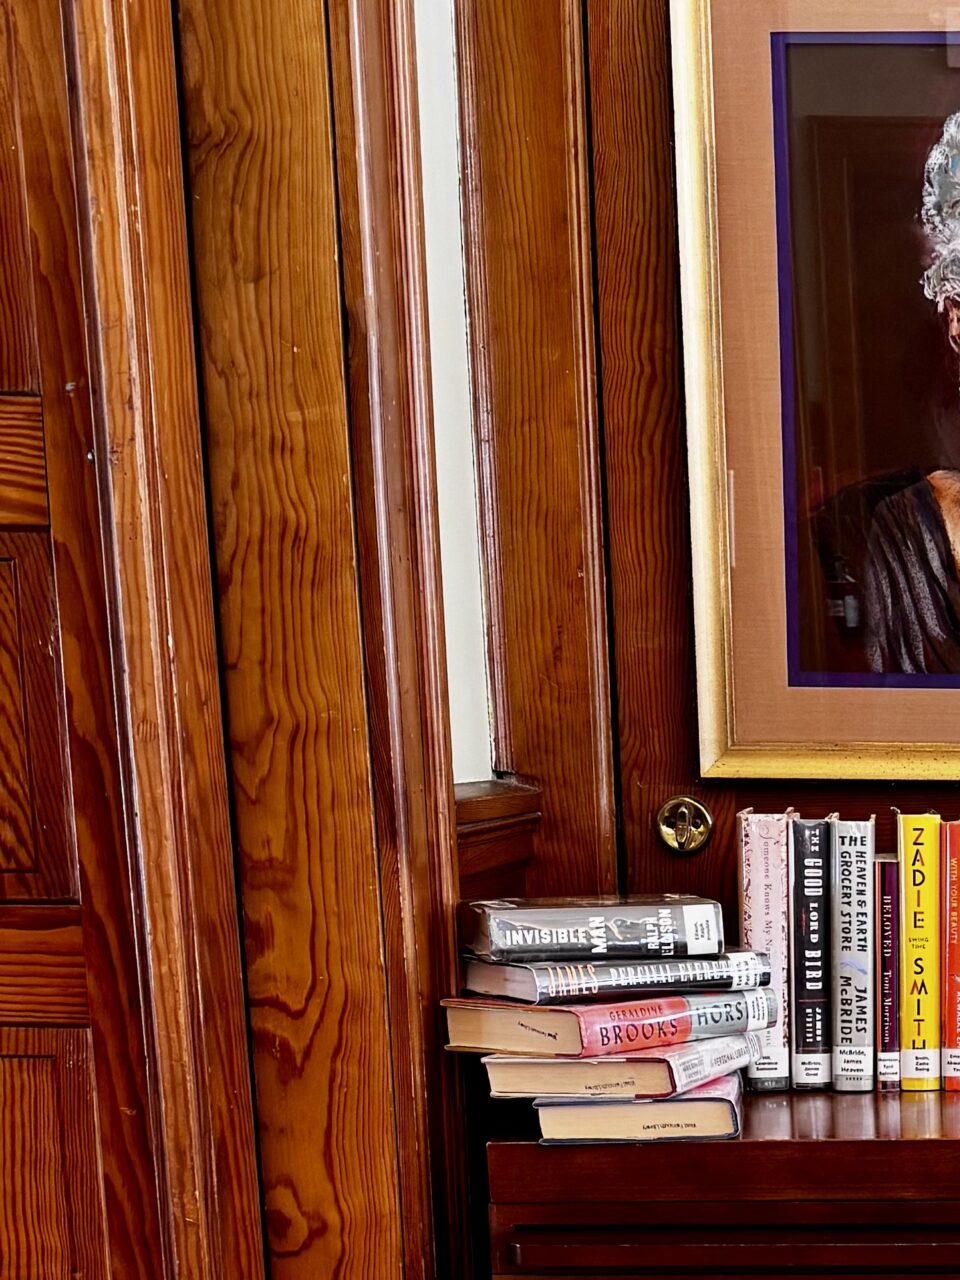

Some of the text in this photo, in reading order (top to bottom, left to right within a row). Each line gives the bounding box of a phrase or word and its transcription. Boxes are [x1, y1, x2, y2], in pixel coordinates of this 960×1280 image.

[839, 835, 867, 847] THE
[855, 851, 867, 896] HEAVEN
[911, 828, 926, 929] ZADIE
[804, 829, 823, 990] THE GOOD LORD BIRD
[840, 851, 852, 952] GROCERY STORE
[505, 927, 588, 946] INVISIBLE
[588, 916, 608, 954] MAN
[856, 912, 868, 953] EARTH
[547, 964, 599, 998] JAMES
[883, 895, 892, 1043] BELOVED Toni Morrison
[609, 1004, 664, 1021] GERALDINE
[840, 976, 852, 1044] McBRIDE
[855, 986, 868, 1034] JAMES
[600, 1017, 679, 1048] BROOKS
